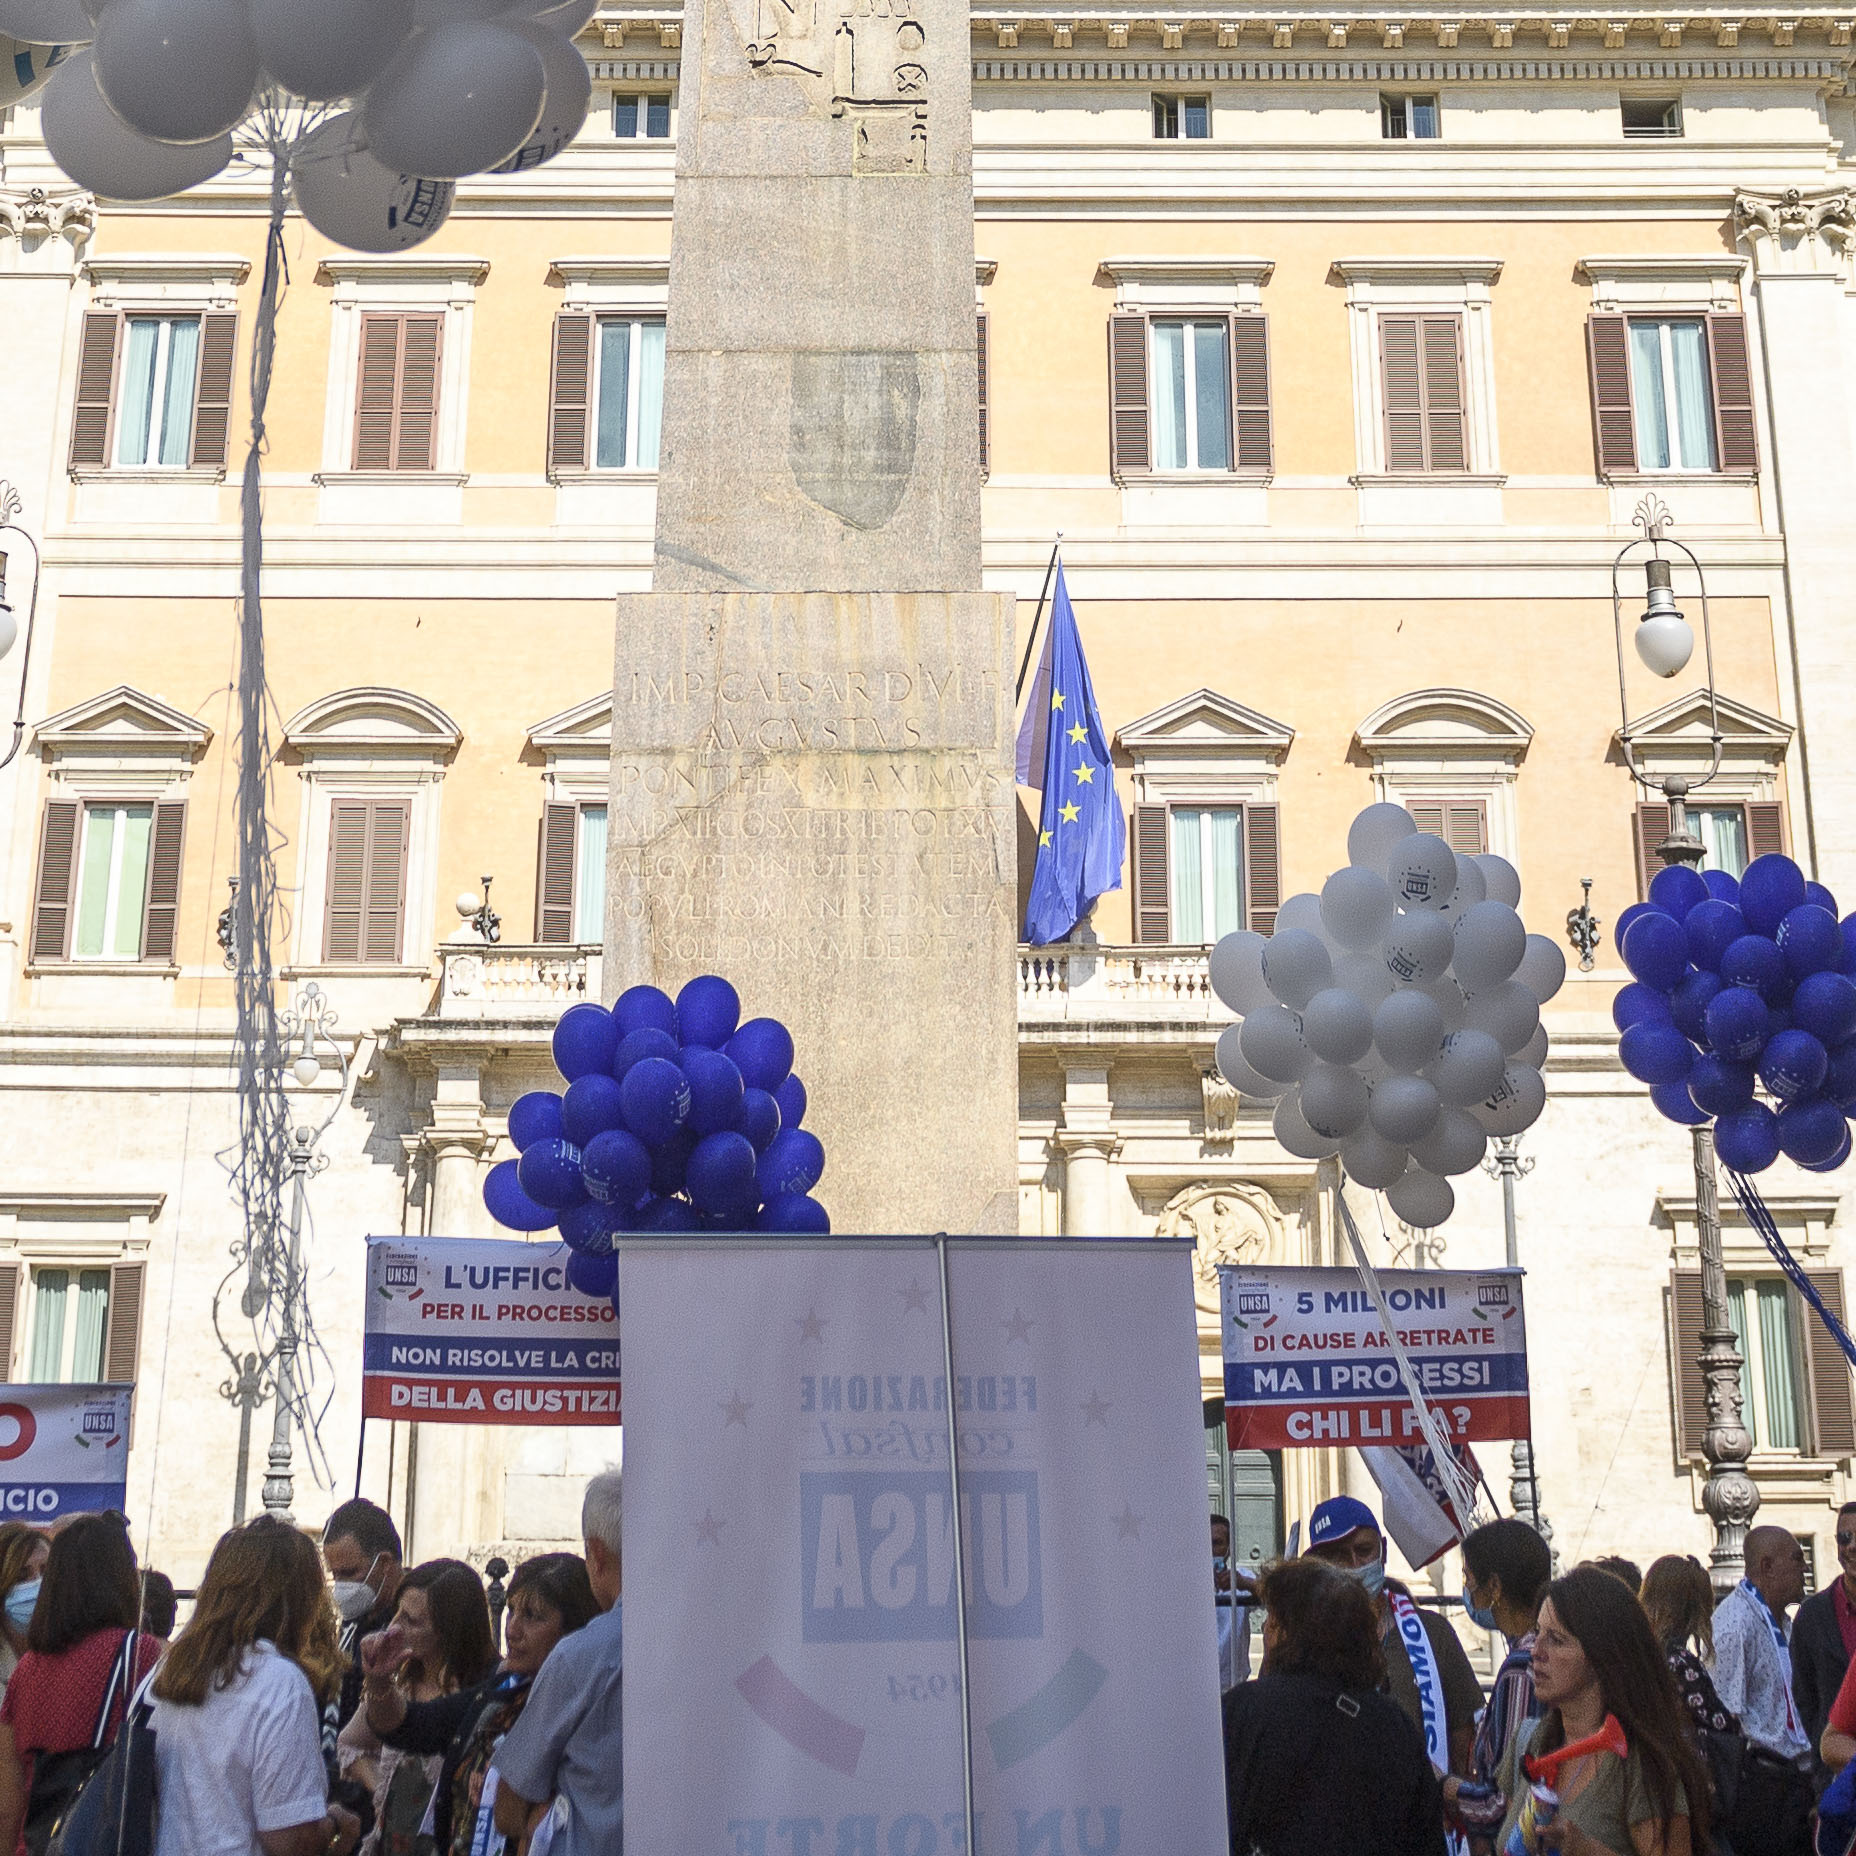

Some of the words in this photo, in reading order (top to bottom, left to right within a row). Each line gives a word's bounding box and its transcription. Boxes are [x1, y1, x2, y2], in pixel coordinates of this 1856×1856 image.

[719, 671, 872, 705] CAESAR
[706, 717, 923, 751] AVGVSTVS
[620, 764, 804, 797] PONTIFEX
[818, 763, 1002, 795] MAXIMVS
[386, 1266, 417, 1286] UNSA
[1240, 1295, 1271, 1314] UNSA
[1296, 1291, 1313, 1314] 5
[1478, 1286, 1509, 1305] UNSA
[421, 1302, 465, 1321] PER
[471, 1303, 491, 1321] IL
[496, 1304, 617, 1323] PROCESSO
[1253, 1335, 1275, 1353] DI
[1282, 1332, 1356, 1351] CAUSE
[391, 1345, 441, 1366] NON
[446, 1347, 544, 1369] RISOLVE
[549, 1350, 580, 1370] LA
[1253, 1368, 1304, 1394] MA
[1312, 1366, 1321, 1392] I
[390, 1383, 487, 1411] DELLA
[83, 1413, 115, 1432] UNSA
[1286, 1409, 1350, 1441] CHI
[1359, 1408, 1393, 1438] LI
[1401, 1616, 1439, 1756] SIAMO
